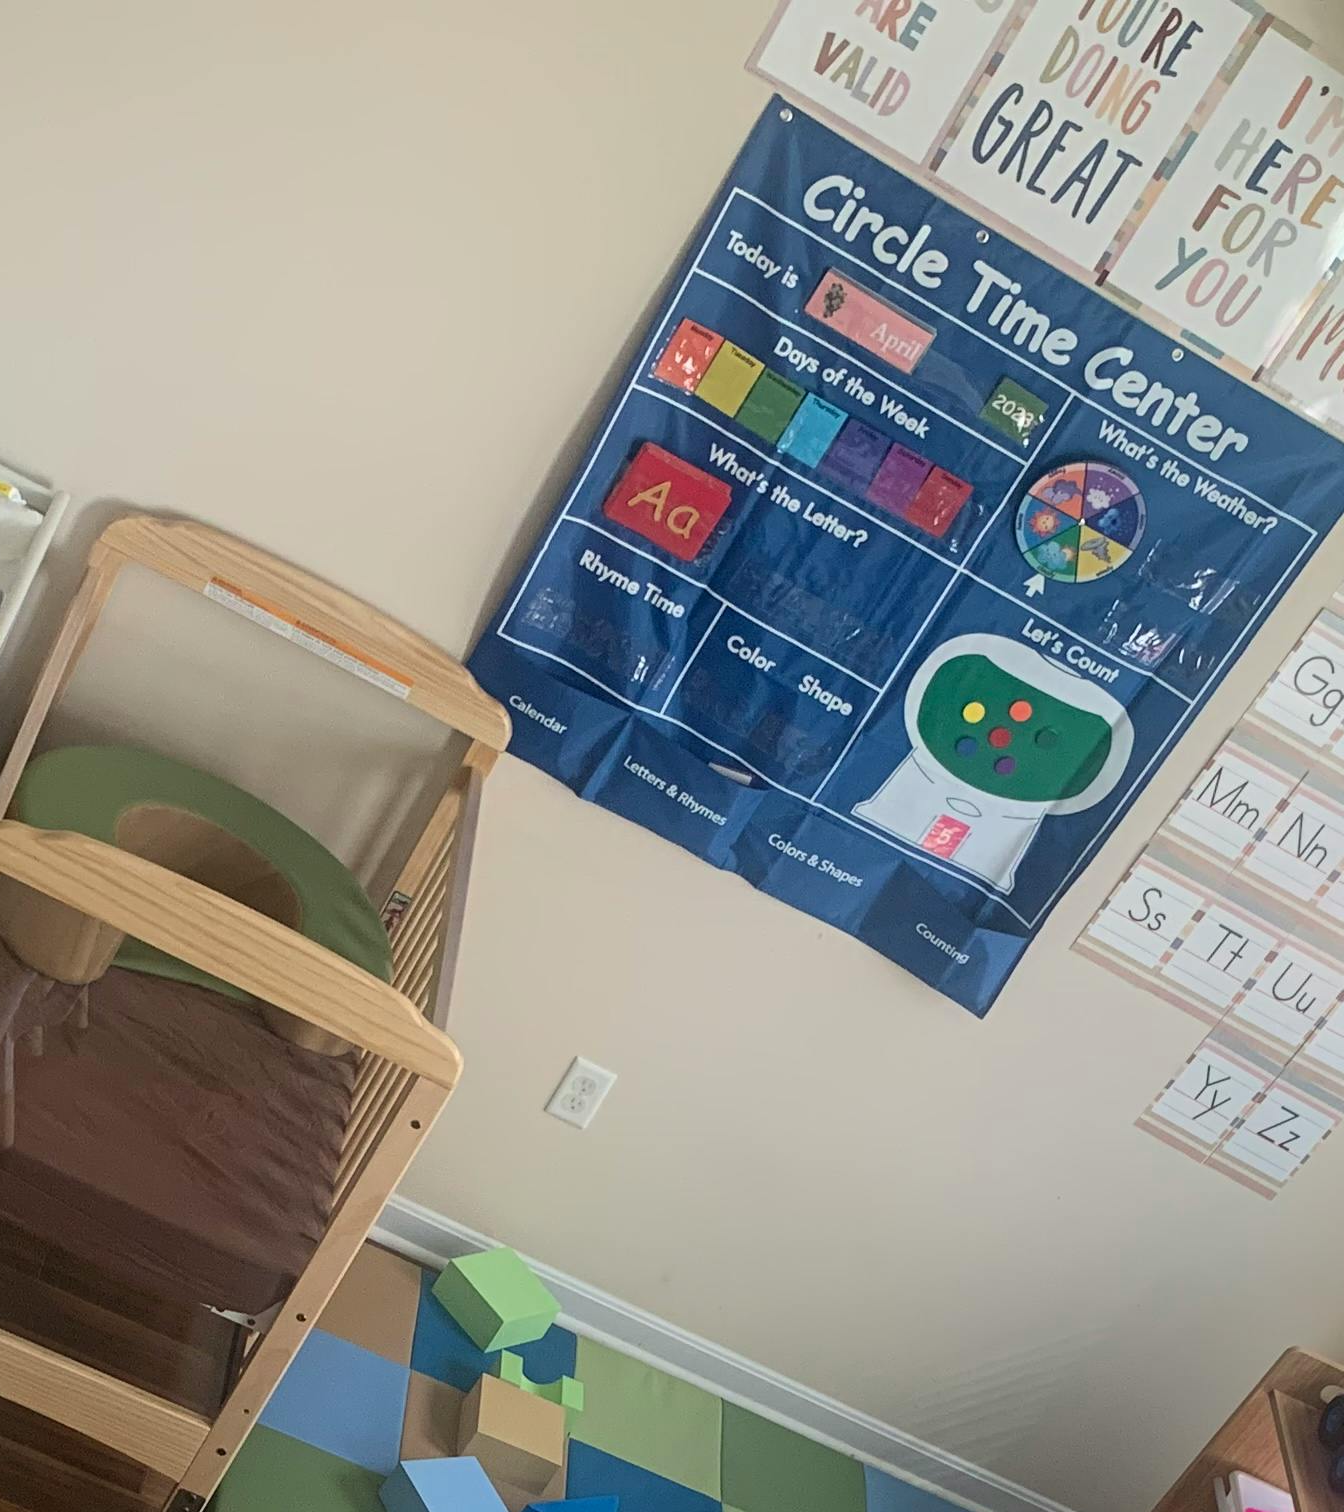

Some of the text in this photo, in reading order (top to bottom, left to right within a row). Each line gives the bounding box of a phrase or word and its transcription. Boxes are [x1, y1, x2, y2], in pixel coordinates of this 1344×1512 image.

[814, 31, 911, 117] VALID
[1039, 25, 1160, 135] DOING
[972, 83, 1143, 224] GREAT
[726, 231, 800, 289] Today is
[1191, 183, 1298, 278] FOR
[802, 174, 1249, 461] Circle Time Center
[1154, 236, 1263, 328] YOU
[870, 322, 921, 362] April
[773, 336, 931, 439] Days of the Week
[627, 480, 701, 540] Aa
[709, 443, 869, 549] What's the Letter?
[1098, 419, 1278, 535] What's the Weather?
[578, 549, 686, 619] Rhyme Time
[726, 634, 853, 717] Color Shape
[1021, 618, 1121, 684] Let's Count
[508, 694, 568, 735] Calendar
[623, 754, 728, 827] Letters & Rhymes
[1195, 766, 1261, 831] Mm
[1276, 811, 1328, 869] Nn
[767, 832, 864, 889] Colors & Shapes
[936, 827, 953, 848] 5
[915, 922, 971, 965] Counting
[1127, 887, 1168, 932] Ss
[1206, 923, 1250, 972] Tt
[1271, 961, 1317, 1015] Uu
[1194, 1064, 1301, 1152] Yy Zz
